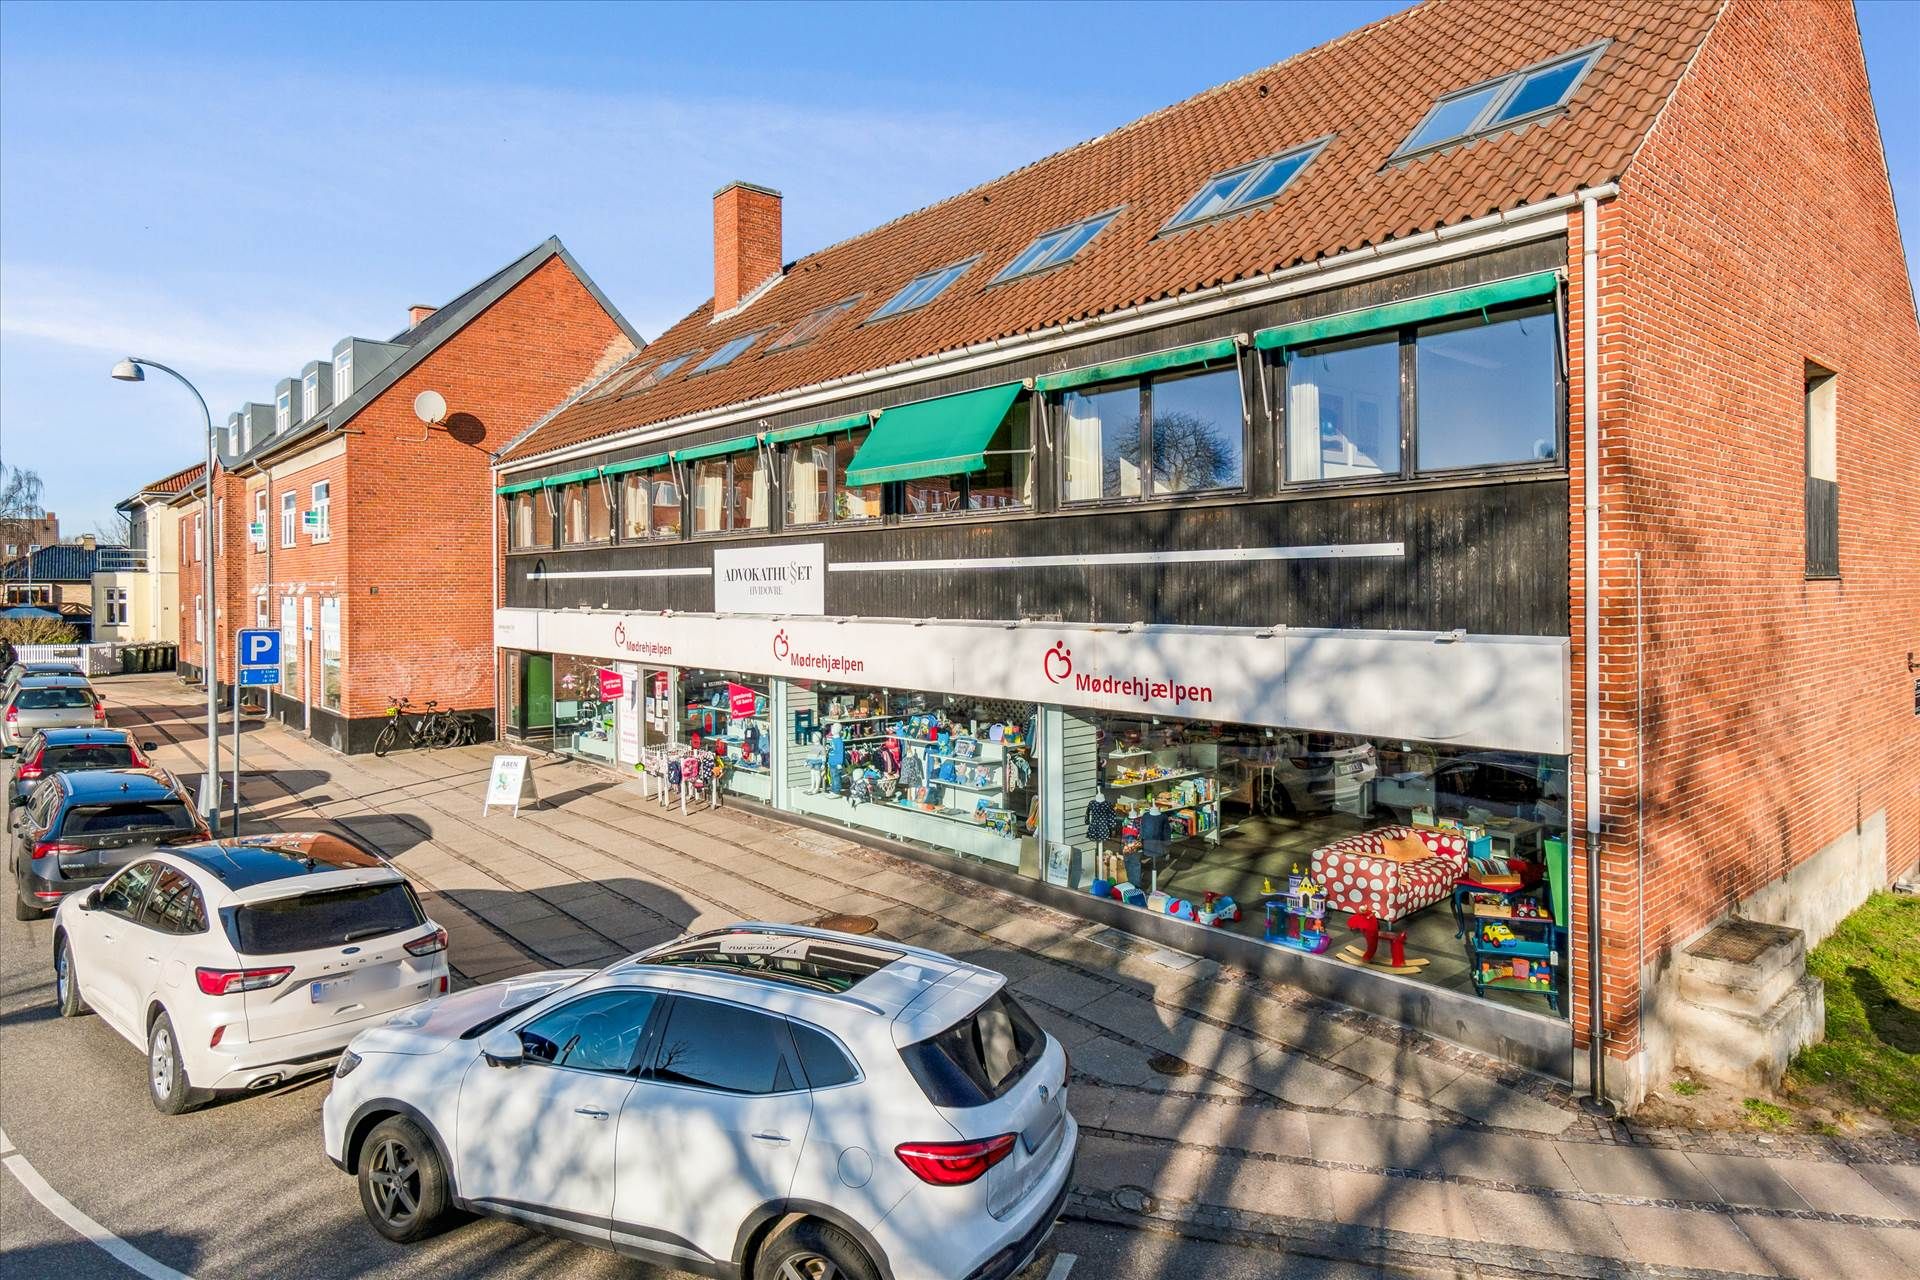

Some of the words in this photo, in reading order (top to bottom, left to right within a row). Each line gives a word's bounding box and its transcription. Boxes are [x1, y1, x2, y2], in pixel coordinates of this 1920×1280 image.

[749, 585, 783, 596] HVIDOVRE
[251, 636, 272, 661] P
[626, 640, 673, 657] Mødrehjælpen
[790, 652, 864, 675] Mødrehjælpen
[1076, 673, 1212, 705] Mødrehjælpen
